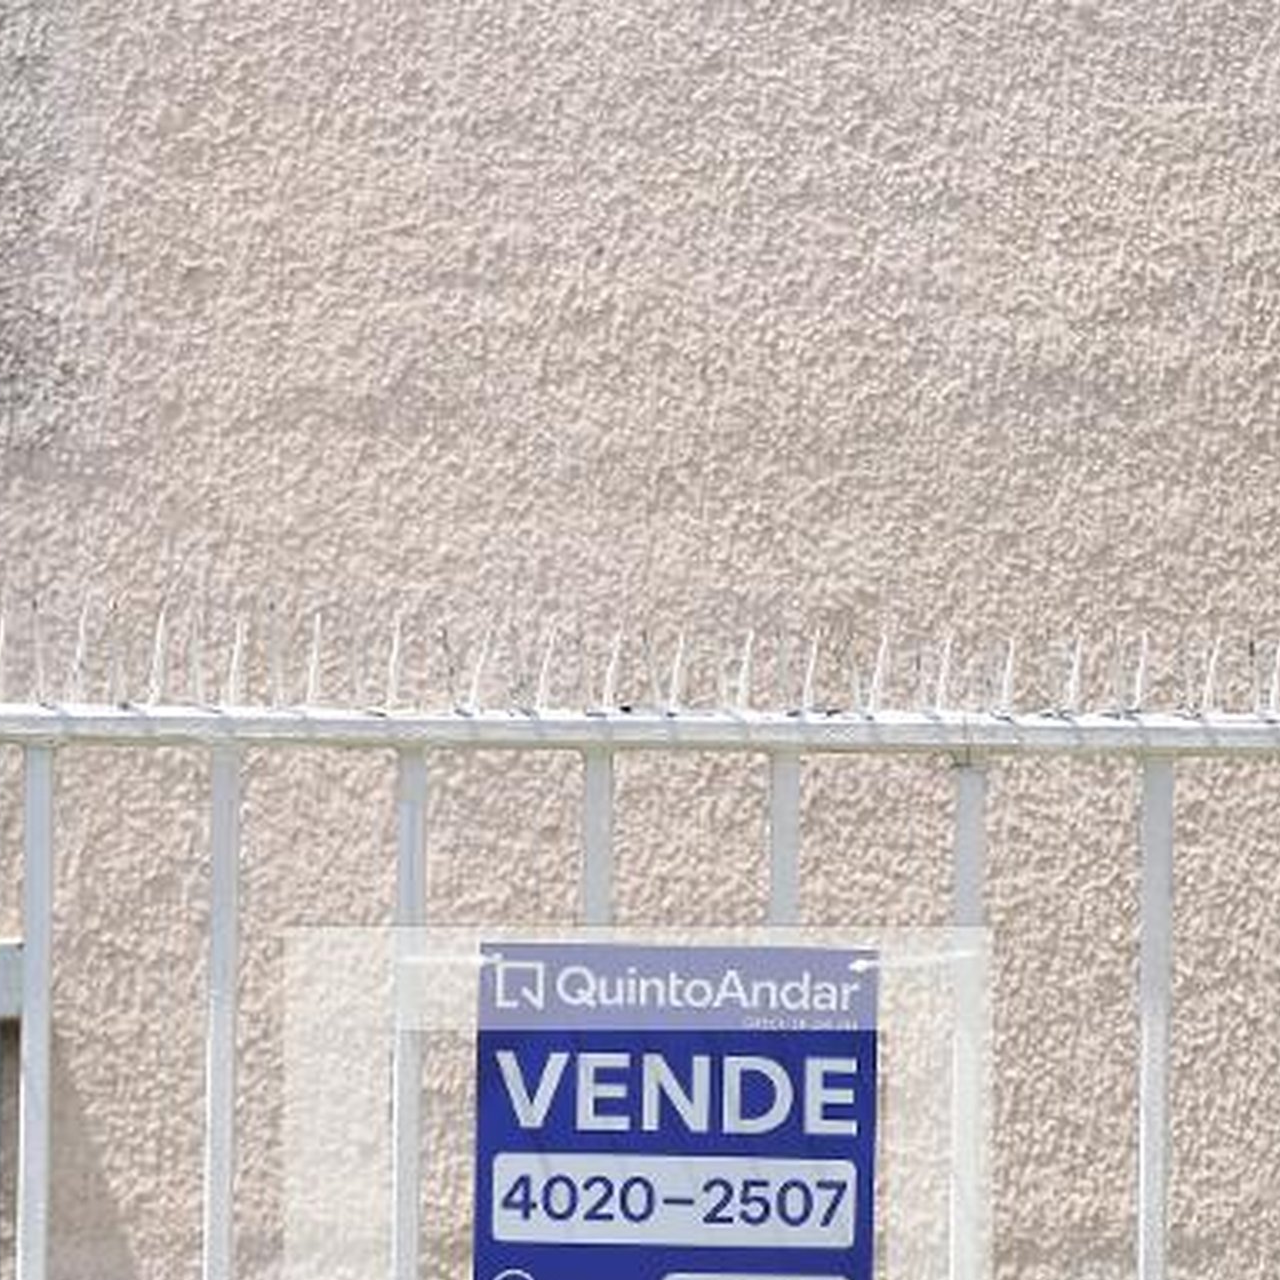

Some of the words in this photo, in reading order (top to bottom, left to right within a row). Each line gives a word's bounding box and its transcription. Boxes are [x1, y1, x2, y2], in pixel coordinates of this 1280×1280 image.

[557, 965, 859, 1012] QuintoAndar
[496, 1050, 858, 1136] VENDE
[501, 1175, 848, 1227] 4020-2507
